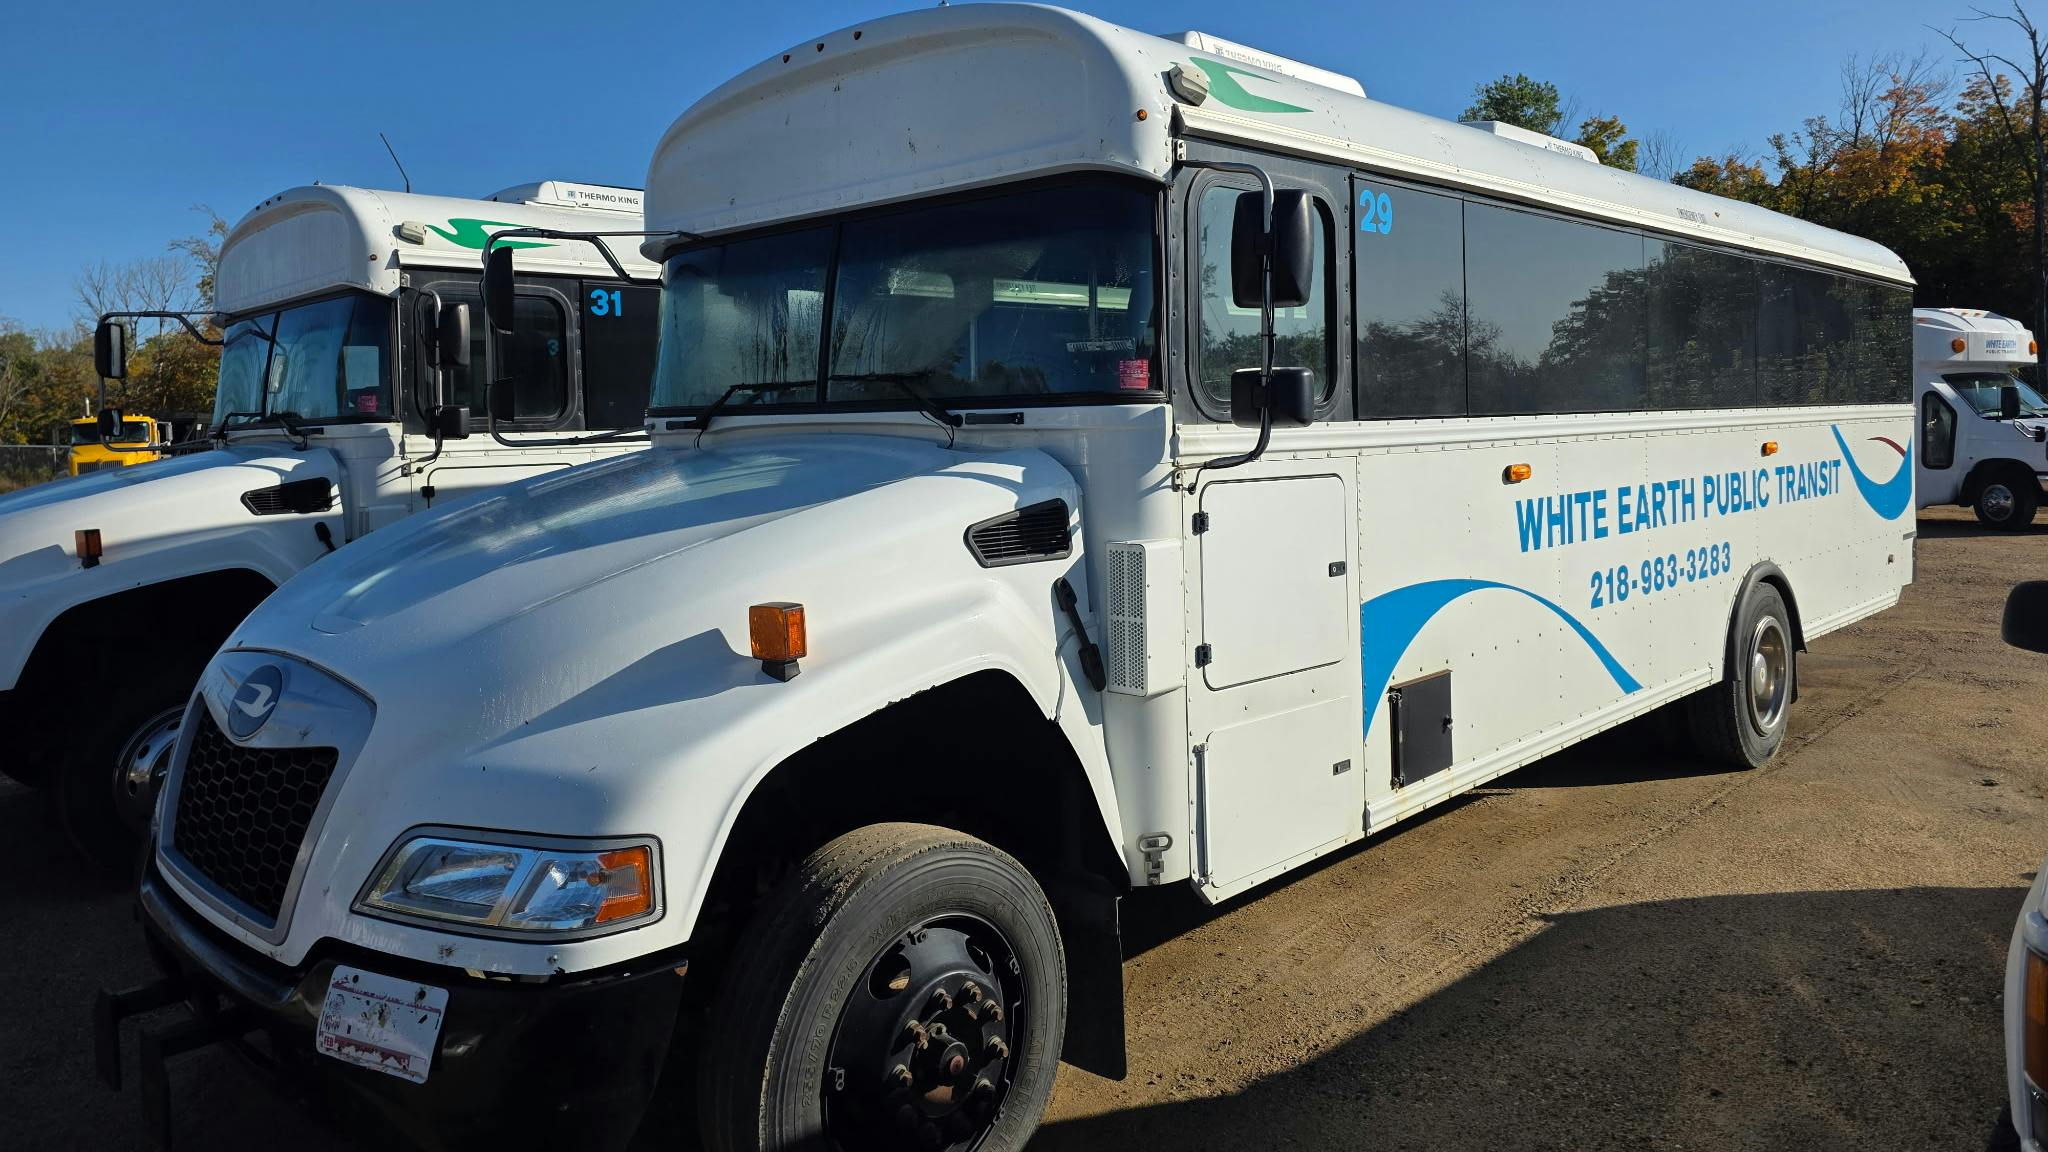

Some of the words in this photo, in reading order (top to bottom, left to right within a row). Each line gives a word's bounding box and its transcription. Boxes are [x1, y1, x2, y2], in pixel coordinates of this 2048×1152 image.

[578, 191, 617, 203] THERMO
[618, 196, 639, 205] KING
[1359, 189, 1393, 235] 29
[590, 288, 622, 317] 31
[1986, 340, 2002, 349] WHITE
[2002, 340, 2017, 349] EARTH
[1516, 489, 1608, 553] WHITE
[1618, 478, 1696, 534] EARTH
[1703, 469, 1770, 518] PUBLIC
[1775, 459, 1841, 505] TRANSIT
[1590, 541, 1731, 609] 218-983-3283
